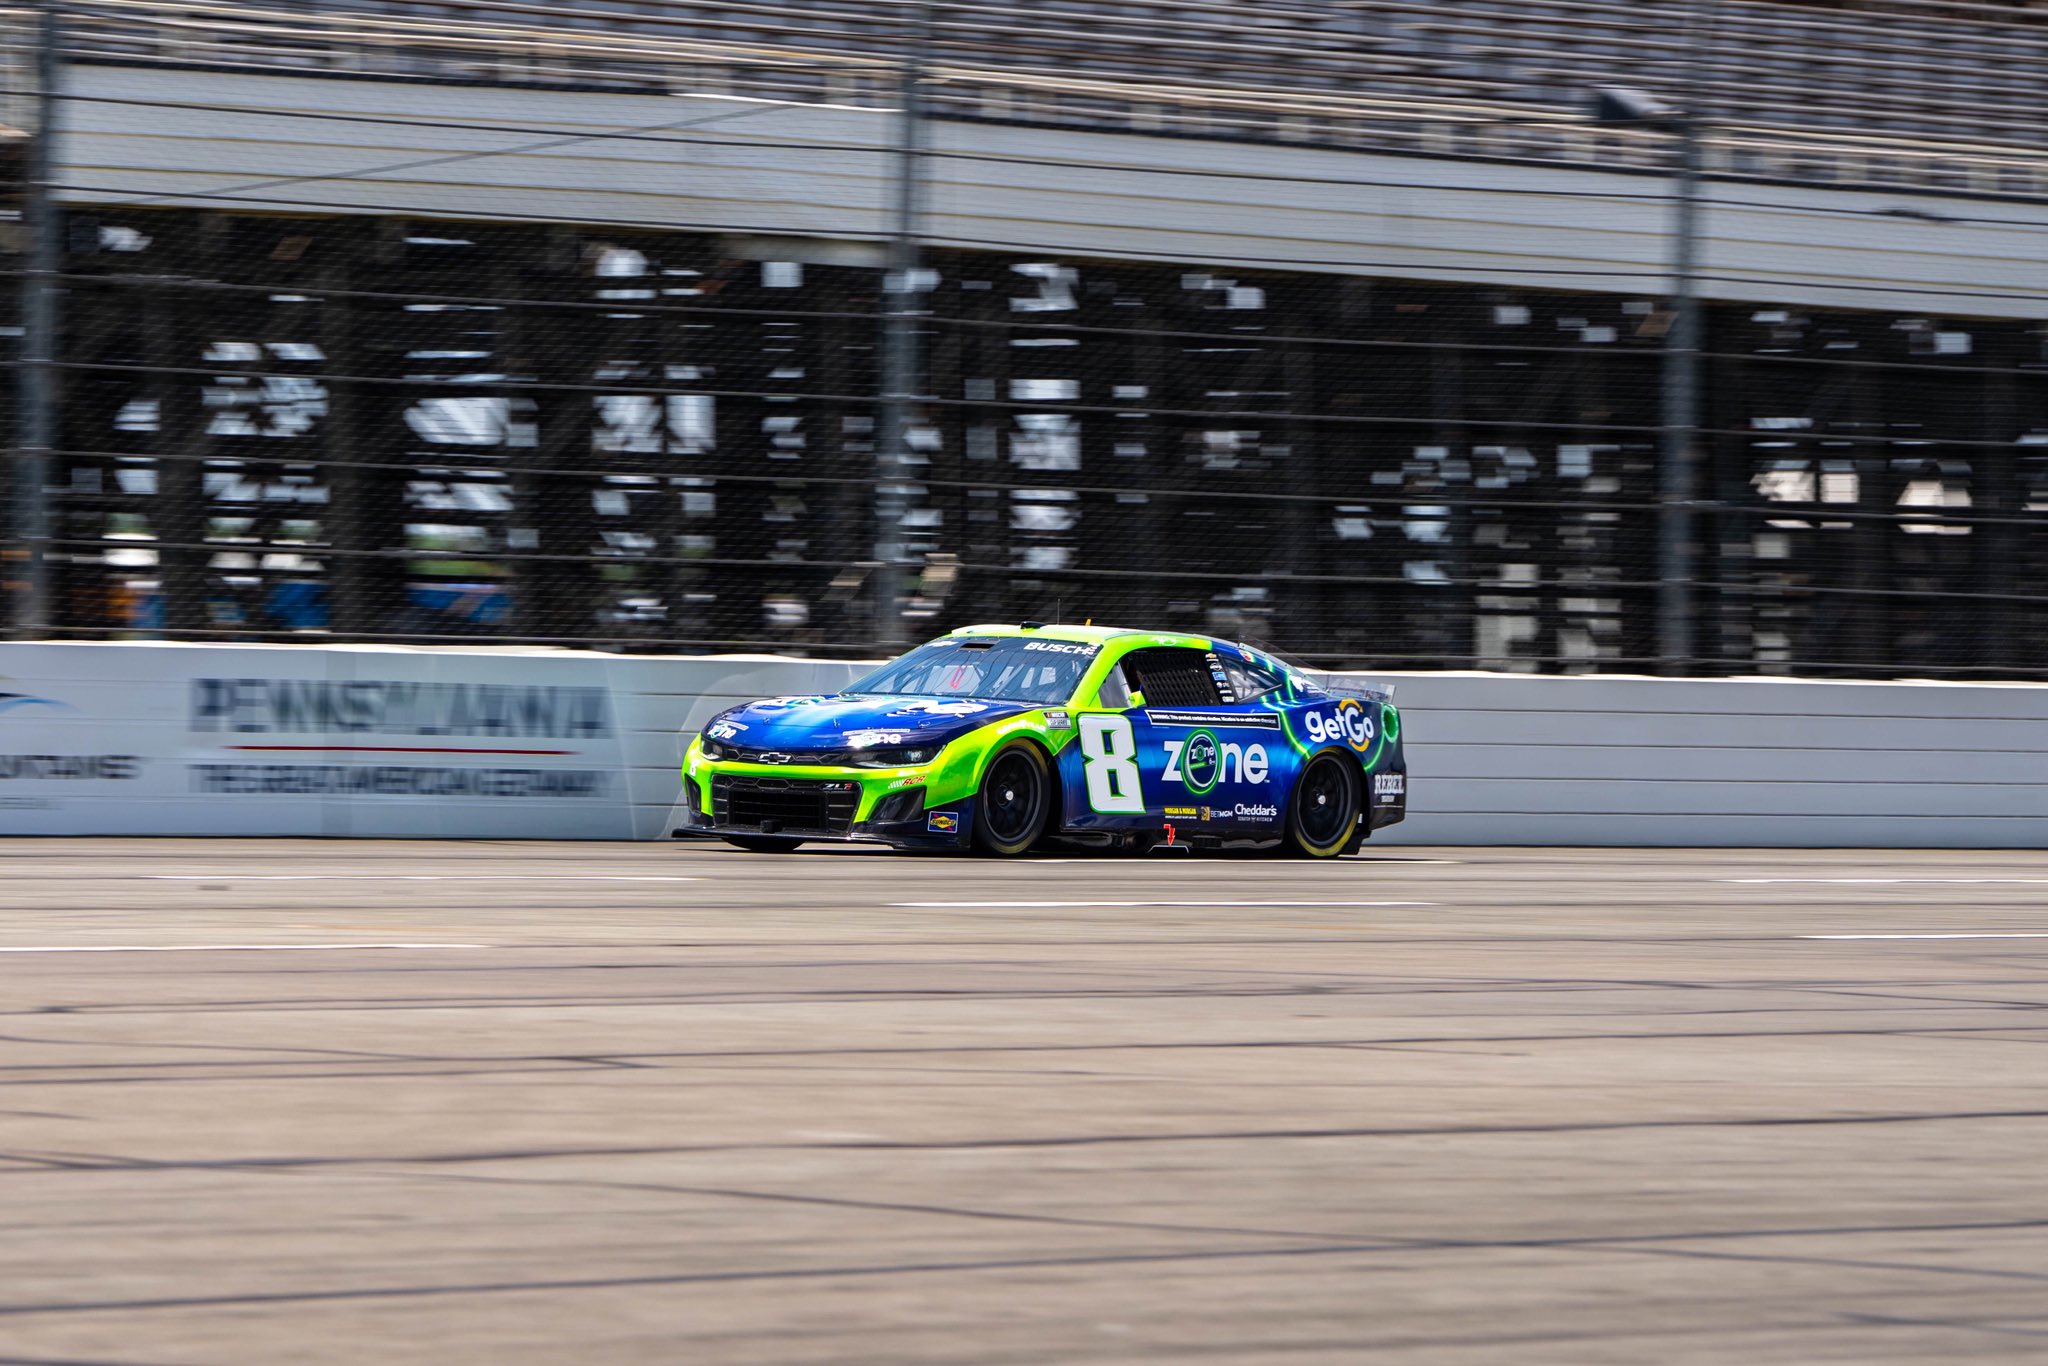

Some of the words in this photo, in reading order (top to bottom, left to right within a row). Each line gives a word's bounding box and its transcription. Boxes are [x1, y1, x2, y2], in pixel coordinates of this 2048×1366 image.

[1305, 707, 1374, 743] getGo
[1077, 713, 1145, 814] 8
[1374, 774, 1405, 794] REBEL
[1234, 803, 1277, 816] Cheddar's
